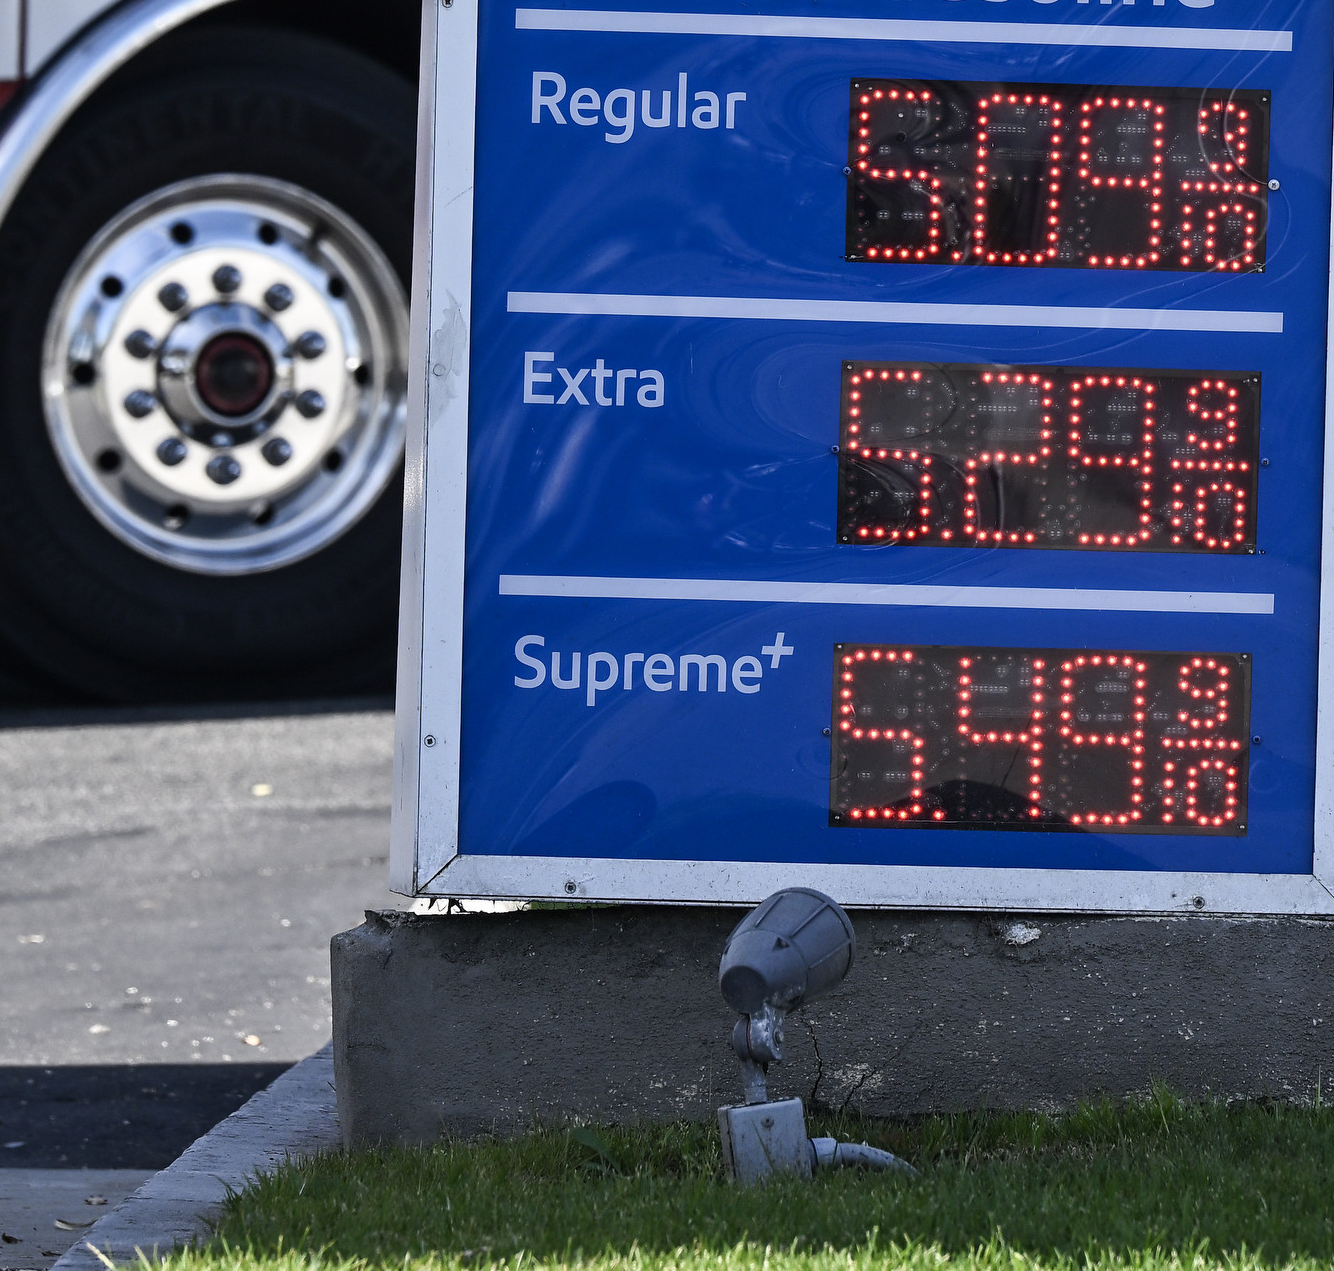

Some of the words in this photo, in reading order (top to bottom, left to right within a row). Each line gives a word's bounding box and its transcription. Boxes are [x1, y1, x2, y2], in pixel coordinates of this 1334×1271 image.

[530, 70, 748, 145] Regular
[855, 84, 1165, 269] 5.09
[522, 350, 666, 409] Extra
[845, 368, 1155, 546] 5.29
[836, 648, 1146, 827] 5.49
